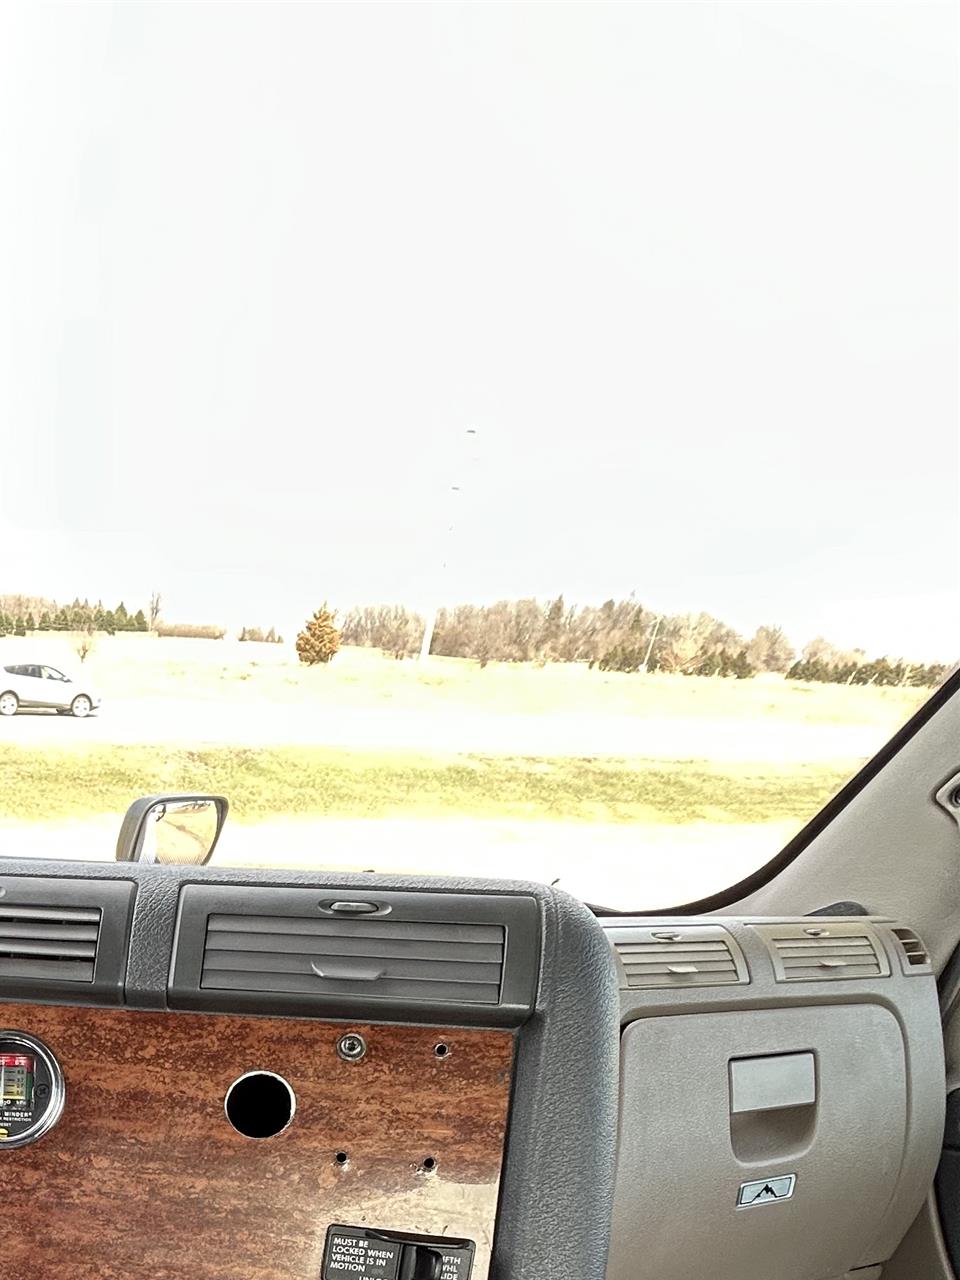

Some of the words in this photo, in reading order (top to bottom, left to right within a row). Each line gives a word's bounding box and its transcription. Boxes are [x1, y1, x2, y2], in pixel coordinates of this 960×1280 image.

[333, 1237, 358, 1247] MUST
[358, 1240, 369, 1248] BE
[332, 1246, 365, 1256] LOCKED
[367, 1249, 394, 1259] WHEN
[331, 1253, 365, 1264] VEHICLE
[366, 1257, 375, 1265] IS
[376, 1259, 386, 1267] IN
[442, 1255, 461, 1265] IFTH
[330, 1261, 365, 1272] MOTION
